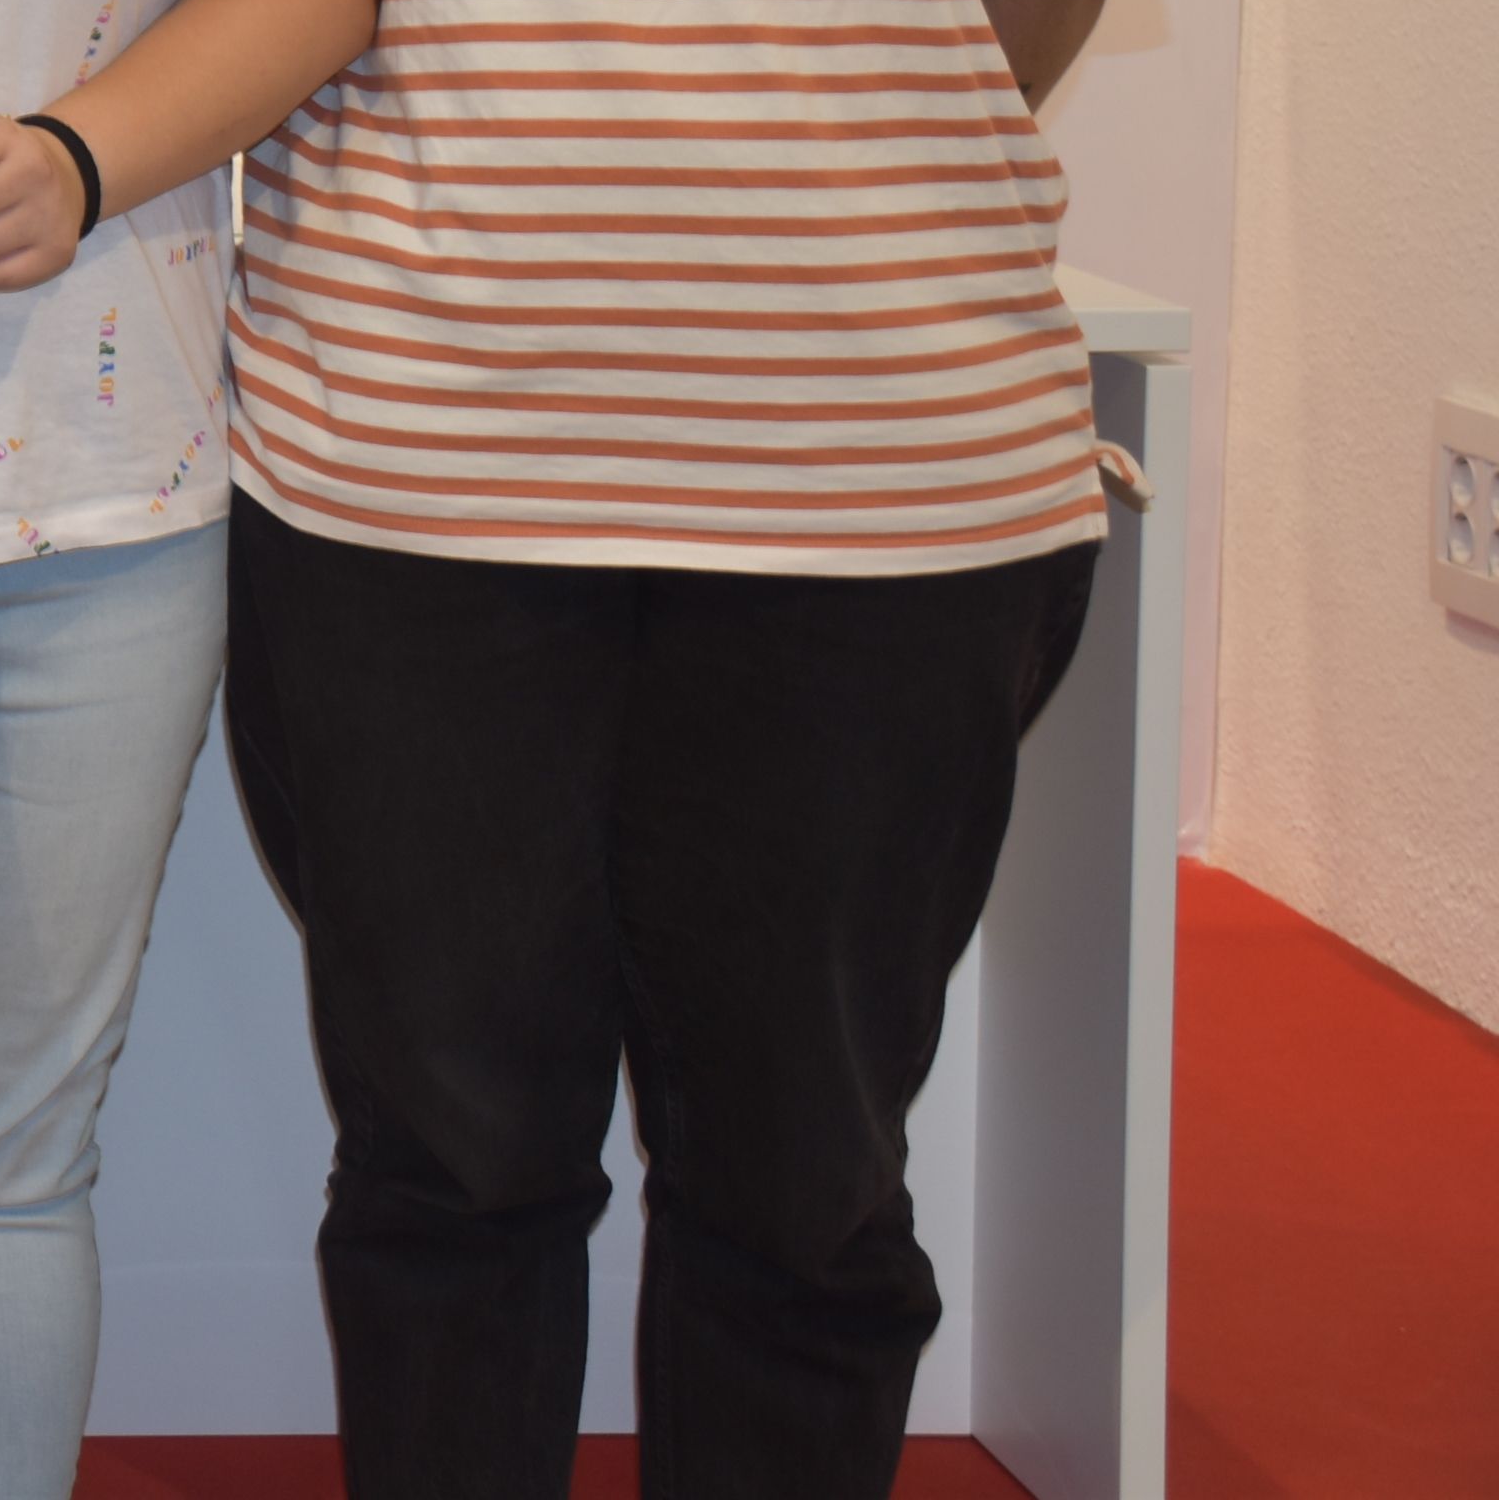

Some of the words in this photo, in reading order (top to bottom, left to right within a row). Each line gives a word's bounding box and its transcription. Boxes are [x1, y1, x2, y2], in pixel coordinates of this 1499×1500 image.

[168, 237, 215, 266] JOYFUL
[98, 307, 116, 406] JOYFUL
[150, 431, 206, 514] JOYFUL
